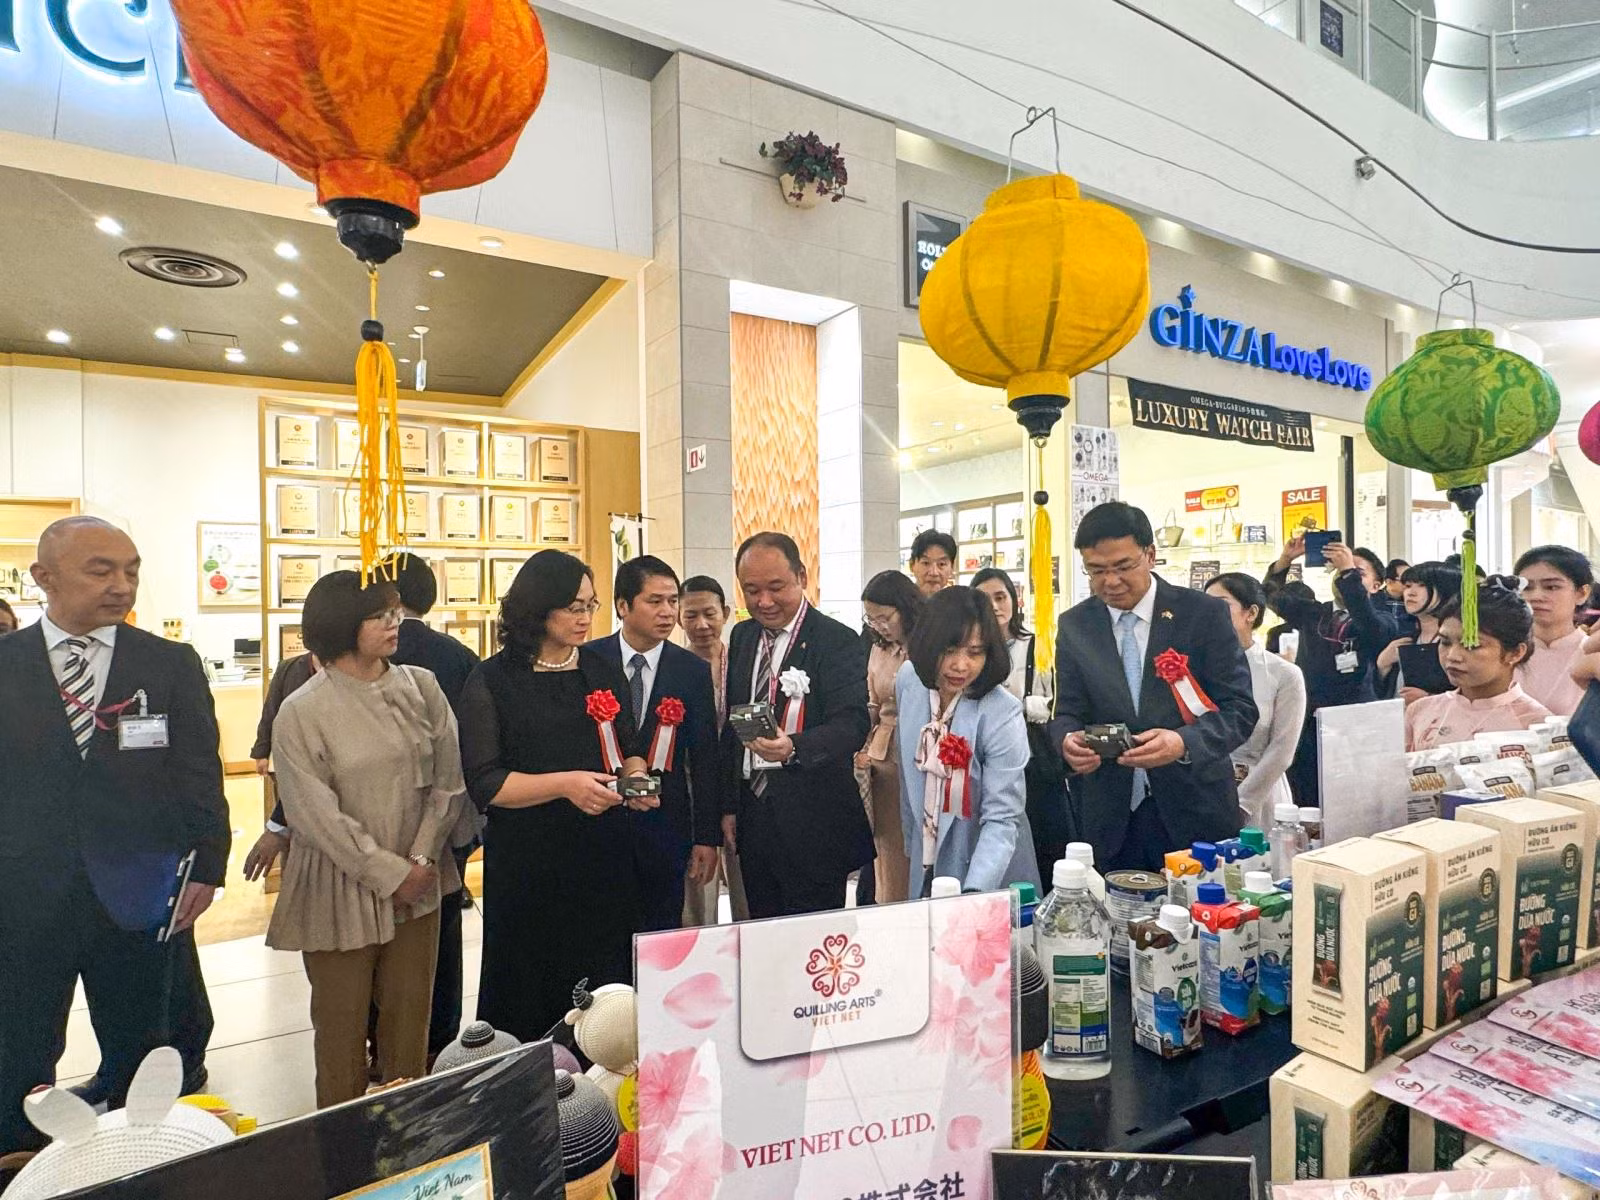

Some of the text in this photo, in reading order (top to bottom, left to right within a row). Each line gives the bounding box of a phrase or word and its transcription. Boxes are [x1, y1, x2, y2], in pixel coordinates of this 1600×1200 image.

[917, 240, 946, 258] ROL
[1150, 285, 1373, 392] GINZA LoveLove
[1135, 398, 1210, 432] LUXURY
[1215, 412, 1274, 441] WATCH
[1083, 471, 1109, 481] OMEGA
[1287, 489, 1321, 504] SALE
[1409, 774, 1448, 792] BANANA
[793, 1000, 847, 1019] QUILLING
[812, 1010, 861, 1027] VIET NET
[741, 1139, 795, 1169] VIET
[800, 1129, 844, 1158] NET
[848, 1122, 887, 1147] CO.
[444, 1173, 473, 1192] Nam
